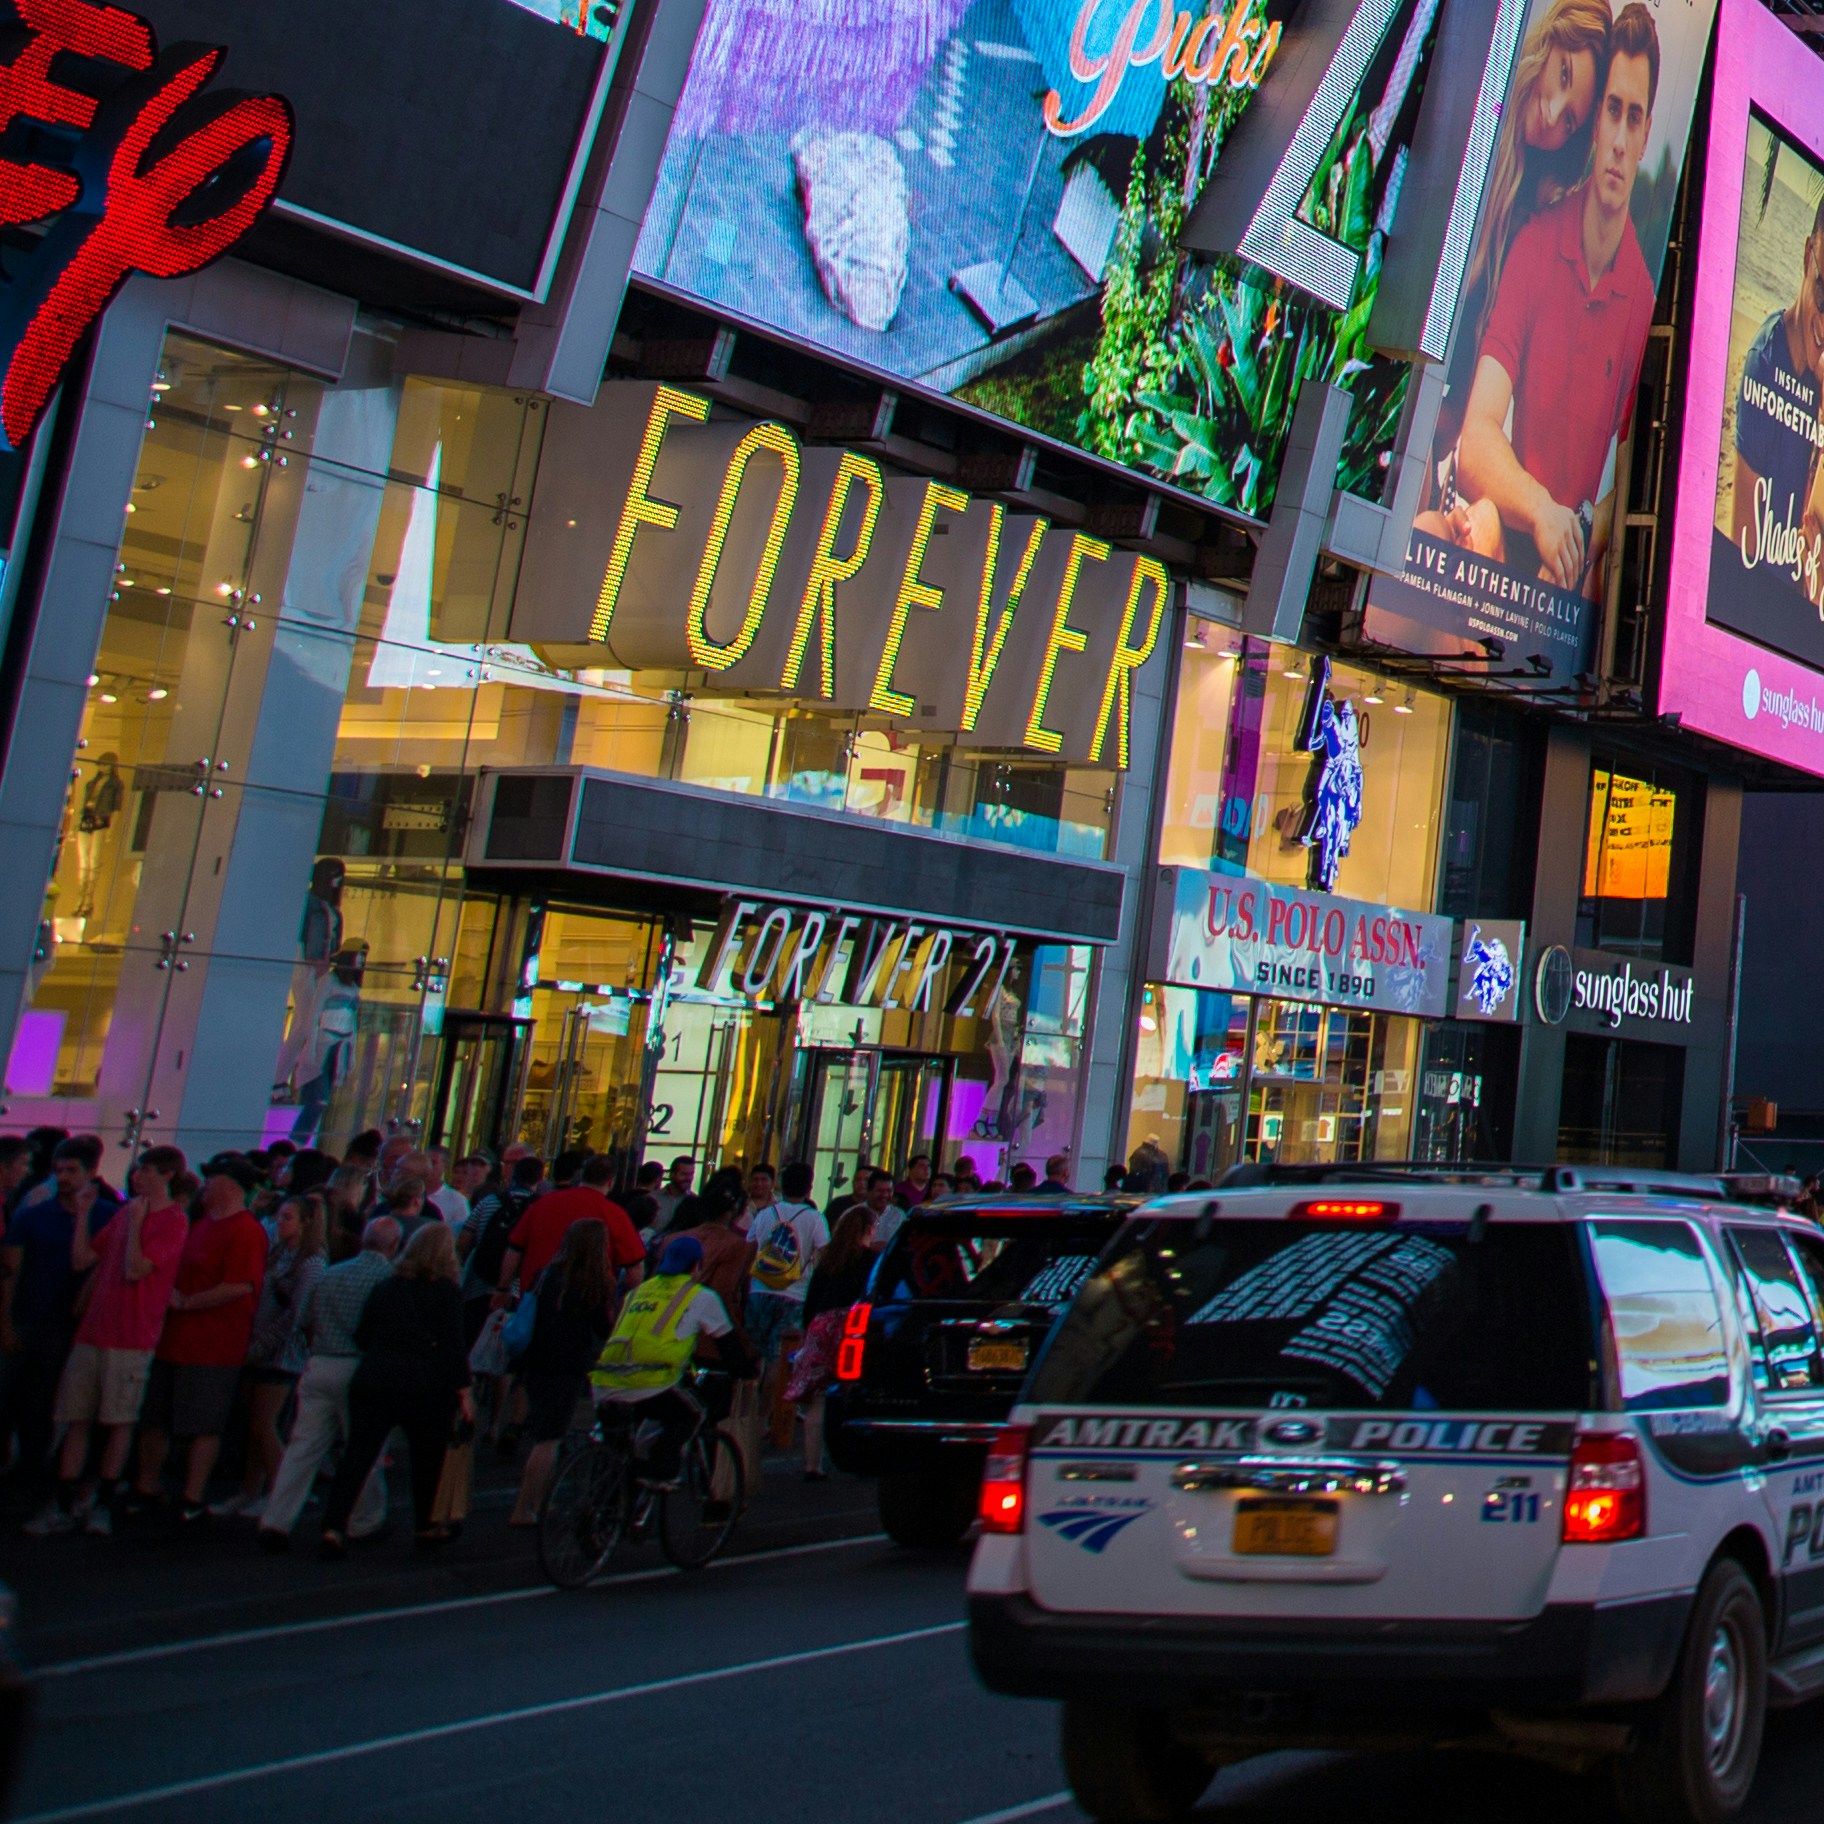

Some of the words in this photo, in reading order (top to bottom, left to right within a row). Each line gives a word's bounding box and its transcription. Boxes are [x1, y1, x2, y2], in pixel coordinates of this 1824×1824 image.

[1773, 366, 1815, 405] INSTANT
[1741, 476, 1803, 582] Shades
[588, 383, 1171, 771] FOREVER
[1405, 541, 1448, 575] LIVE
[1454, 560, 1581, 626] AUTHENTICALLY
[1803, 549, 1820, 602] of
[1400, 570, 1431, 592] PAMELA
[1432, 583, 1473, 608] FLANAGAN
[1480, 601, 1505, 620] JONNY
[1505, 611, 1530, 630] LAVINE
[1534, 622, 1552, 639] POLO
[1552, 629, 1579, 647] PLAYERS
[1762, 684, 1809, 734] sunglass
[706, 900, 954, 1014] FOREVER
[961, 934, 1017, 1019] 21
[1207, 884, 1258, 945] U.S.
[1266, 895, 1347, 958] POLO
[1349, 913, 1426, 970] ASSN.
[1257, 961, 1319, 991] SINCE
[1327, 970, 1376, 999] 1890
[1575, 963, 1658, 1028] sunglass
[1661, 969, 1695, 1024] hut
[1042, 1418, 1254, 1449] AMTRAK
[1351, 1420, 1544, 1453] POLICE
[1480, 1493, 1539, 1523] 211
